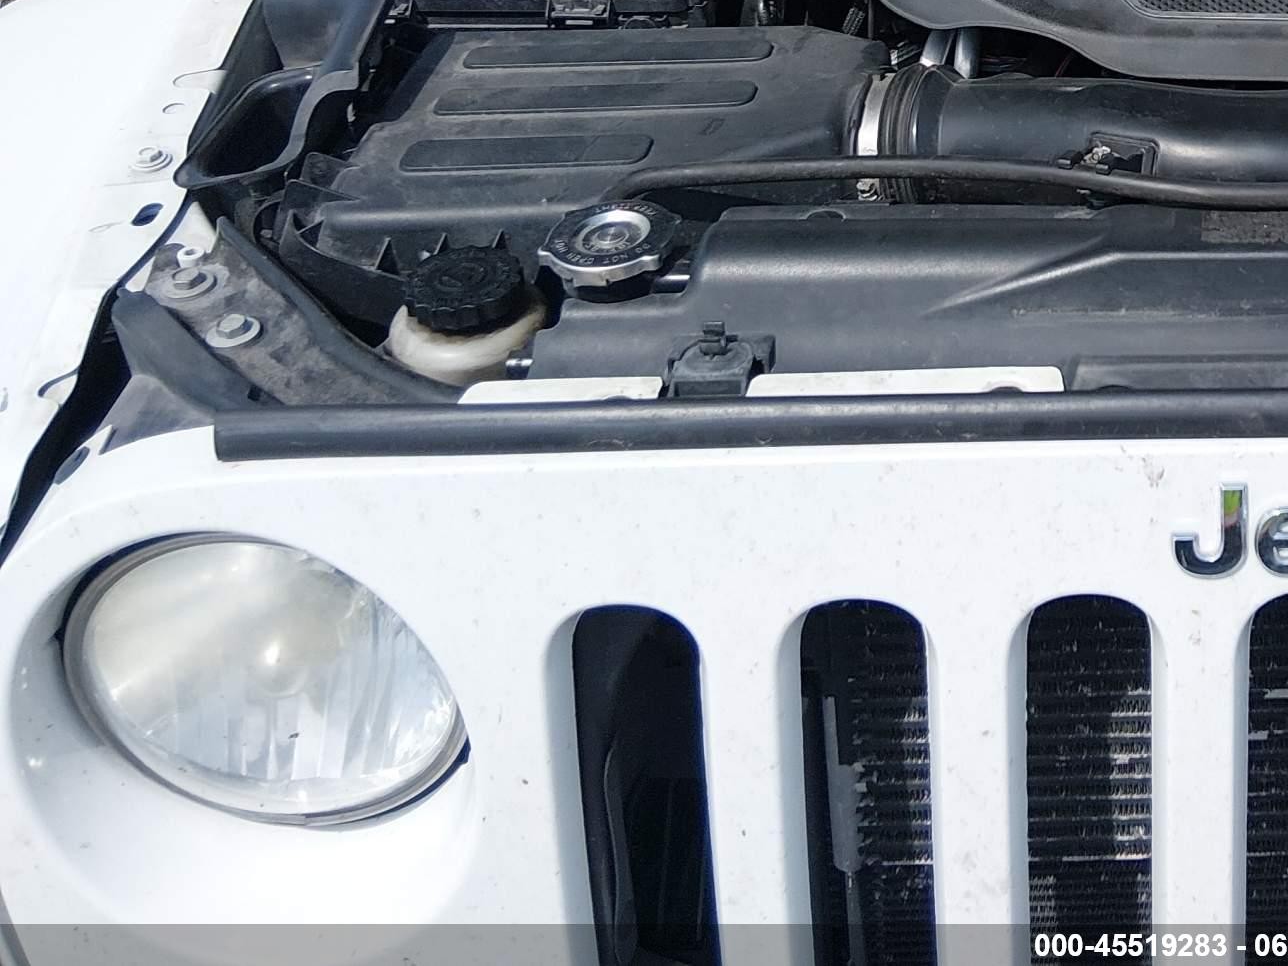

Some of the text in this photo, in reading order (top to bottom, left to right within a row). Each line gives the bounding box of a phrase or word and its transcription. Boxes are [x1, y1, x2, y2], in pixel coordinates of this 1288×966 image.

[634, 242, 652, 254] DO
[566, 252, 595, 265] OPEN
[602, 253, 629, 265] NOT
